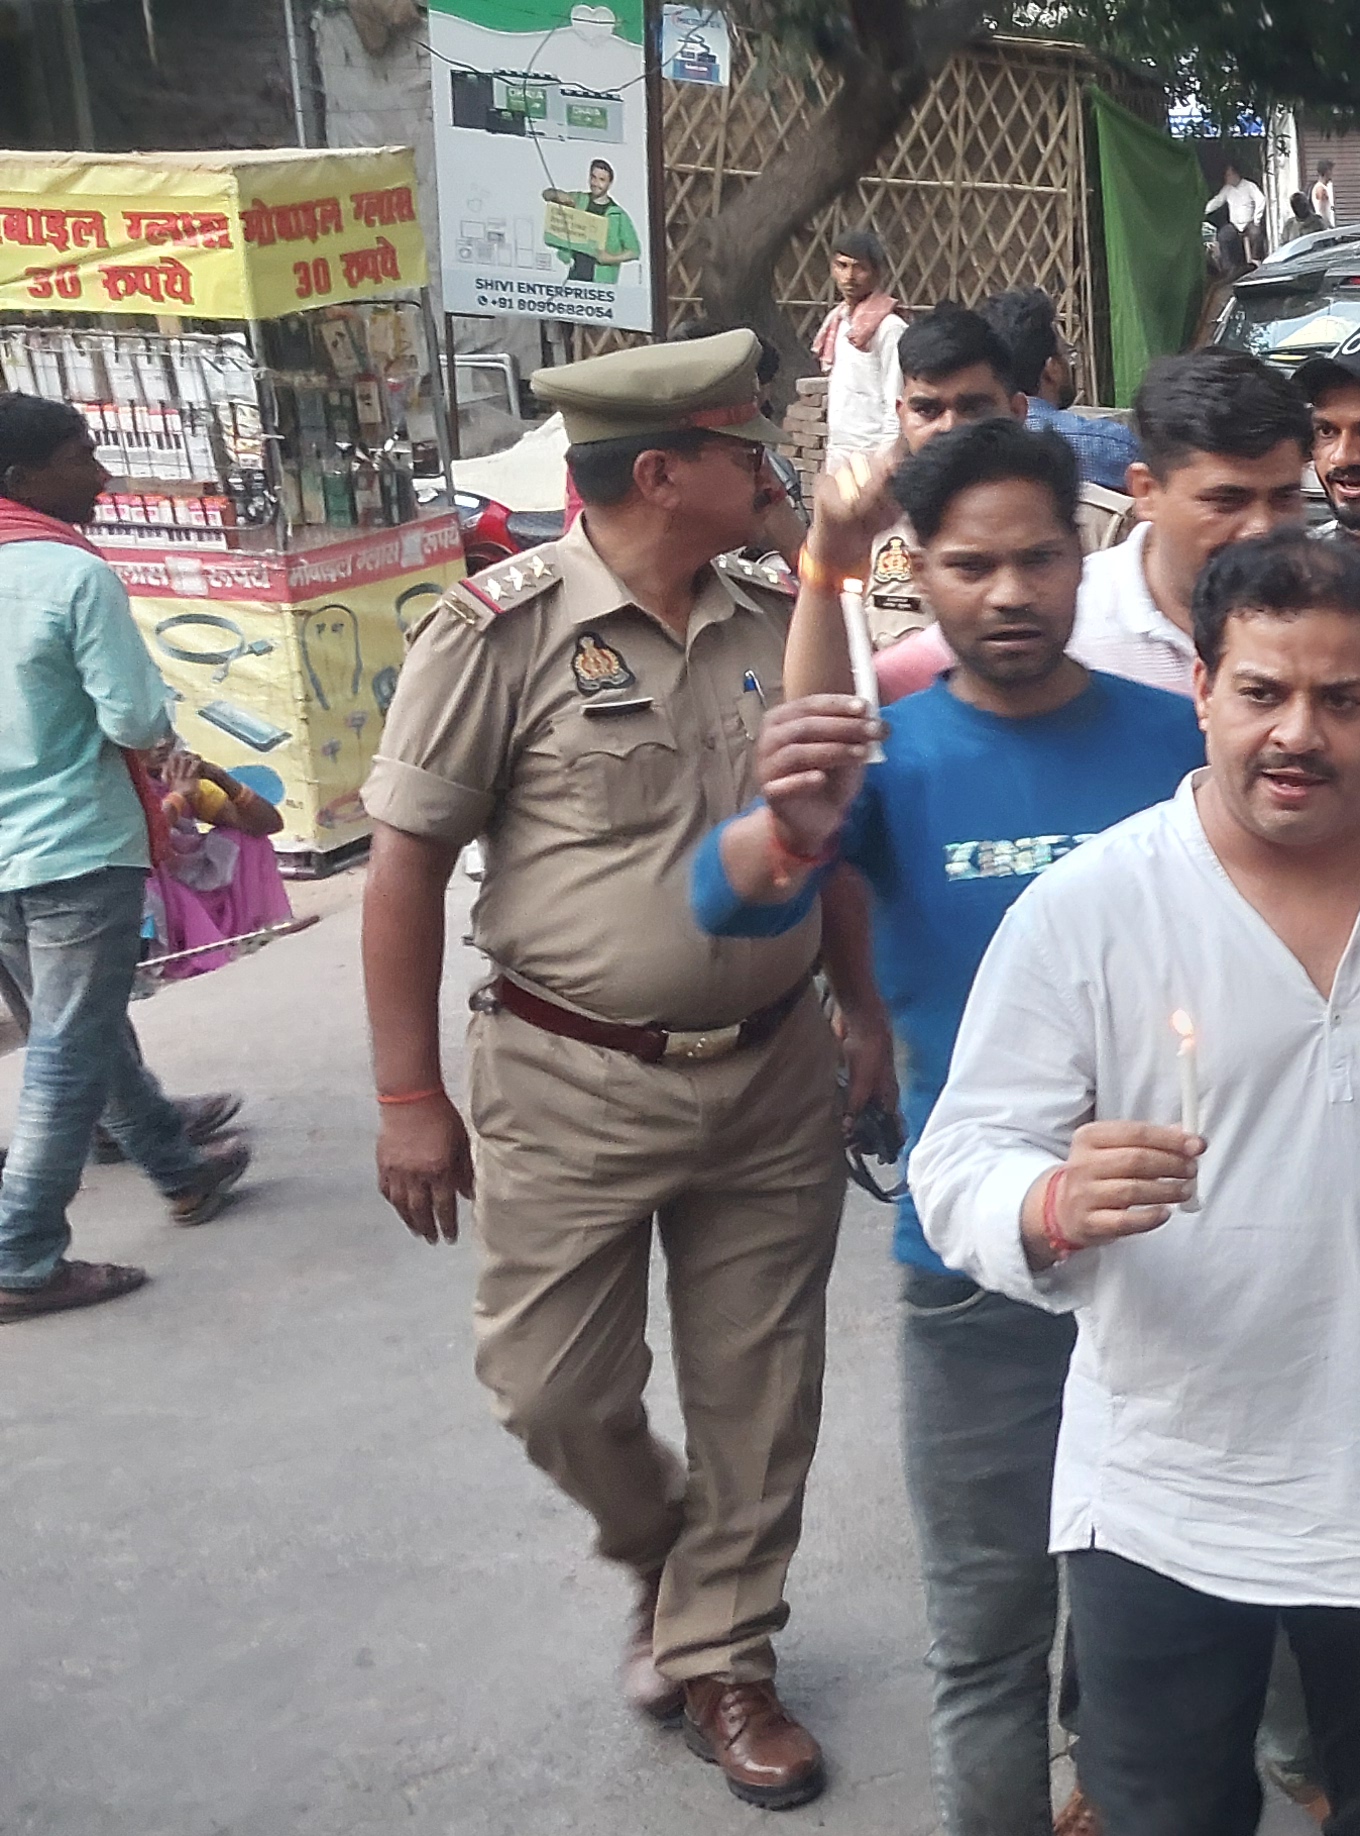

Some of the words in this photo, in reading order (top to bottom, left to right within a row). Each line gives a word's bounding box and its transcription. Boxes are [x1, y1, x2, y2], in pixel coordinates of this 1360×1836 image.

[0, 207, 110, 253] बाइल
[122, 210, 235, 250] ग्लास
[239, 197, 344, 247] मोबाइल
[350, 187, 417, 228] ग्लास
[26, 264, 83, 300] 30
[293, 257, 332, 299] 30
[475, 278, 514, 294] SHIVI
[517, 284, 616, 303] ENTERPRISES
[491, 296, 514, 309] +91
